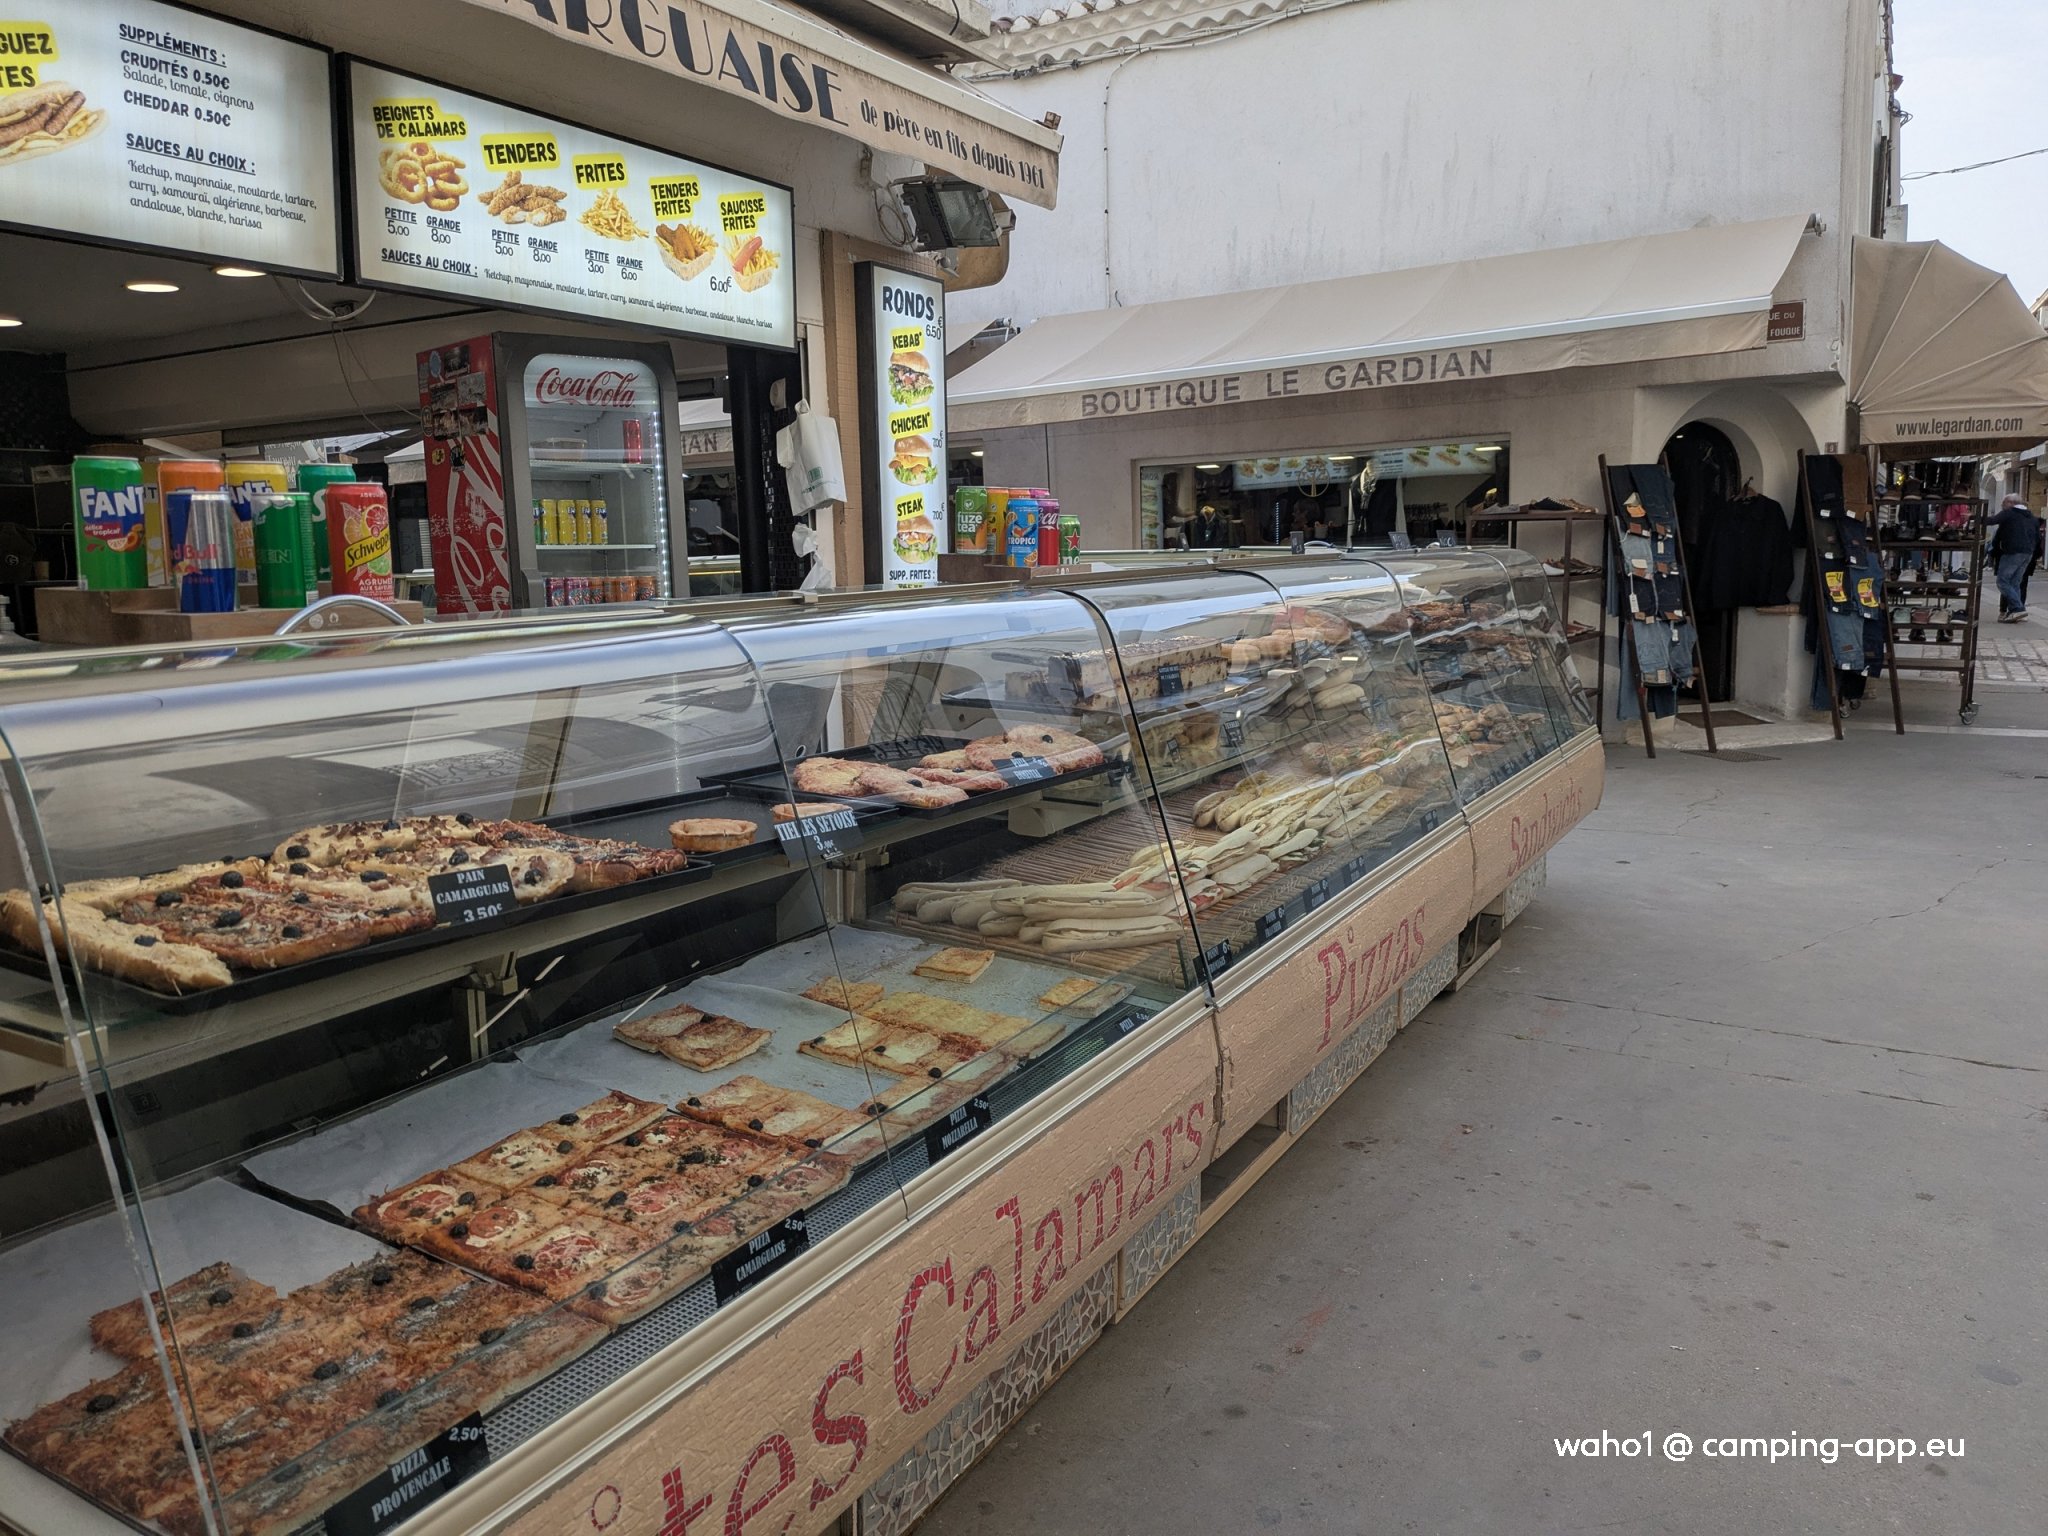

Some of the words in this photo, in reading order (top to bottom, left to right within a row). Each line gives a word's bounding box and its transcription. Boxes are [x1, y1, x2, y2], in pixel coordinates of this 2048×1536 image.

[119, 23, 217, 62] SUPPLÉMENTS
[120, 49, 189, 80] CRUDITÉS
[193, 69, 230, 90] 0.50€
[123, 64, 168, 90] Salade,
[123, 89, 189, 117] CHEDDAR
[194, 107, 231, 127] 0.50€
[373, 105, 435, 122] BEIGNETS
[376, 123, 394, 139] DE
[398, 121, 467, 138] CALAMARS
[126, 132, 181, 156] SAUCES
[186, 146, 204, 162] AU
[209, 151, 247, 172] CHOIX
[483, 142, 557, 165] TENDERS
[861, 98, 878, 127] de
[883, 109, 920, 142] père
[924, 126, 943, 150] en
[946, 130, 968, 161] fils
[972, 143, 1016, 178] depuis
[1018, 161, 1045, 189] 1961
[575, 162, 625, 185] FRITES
[651, 182, 699, 200] TENDERS
[385, 207, 417, 222] PETITE
[426, 215, 461, 231] GRANDE
[654, 198, 691, 216] FRITES
[720, 198, 765, 216] SAUCISSE
[722, 215, 756, 231] FRITES
[491, 229, 520, 244] PETITE
[527, 237, 558, 251] GRANDE
[381, 248, 422, 266] SAUCES
[425, 255, 439, 268] AU
[442, 259, 472, 275] CHOIX
[585, 249, 610, 262] PETITE
[616, 255, 643, 269] GRANDE
[882, 285, 935, 321] RONDS
[535, 367, 640, 409] Coca-Cola
[1081, 376, 1241, 417] BOUTIQUE
[1266, 369, 1299, 397] LE
[1324, 348, 1493, 391] GARDIAN
[1896, 416, 2023, 438] www.legardian.com
[896, 497, 923, 517] STEAK
[958, 511, 983, 524] fuze
[958, 522, 976, 532] tea
[1008, 537, 1036, 545] TROPICO
[889, 569, 908, 581] SUPP.
[909, 569, 931, 580] FRITES
[1507, 778, 1583, 877] Sandwichs
[456, 869, 486, 884] PAIN
[436, 881, 510, 905] CAMARGUAIS
[1317, 906, 1426, 1053] Pizzas
[949, 1105, 967, 1126] PIZZA
[941, 1116, 979, 1150] MOZZARELLA
[748, 1230, 771, 1255] PIZZA
[736, 1239, 787, 1282] CAMARGUAISE
[893, 1102, 1205, 1416] Calamars
[390, 1447, 428, 1484] PIZZA
[371, 1455, 451, 1523] PROVENCALE
